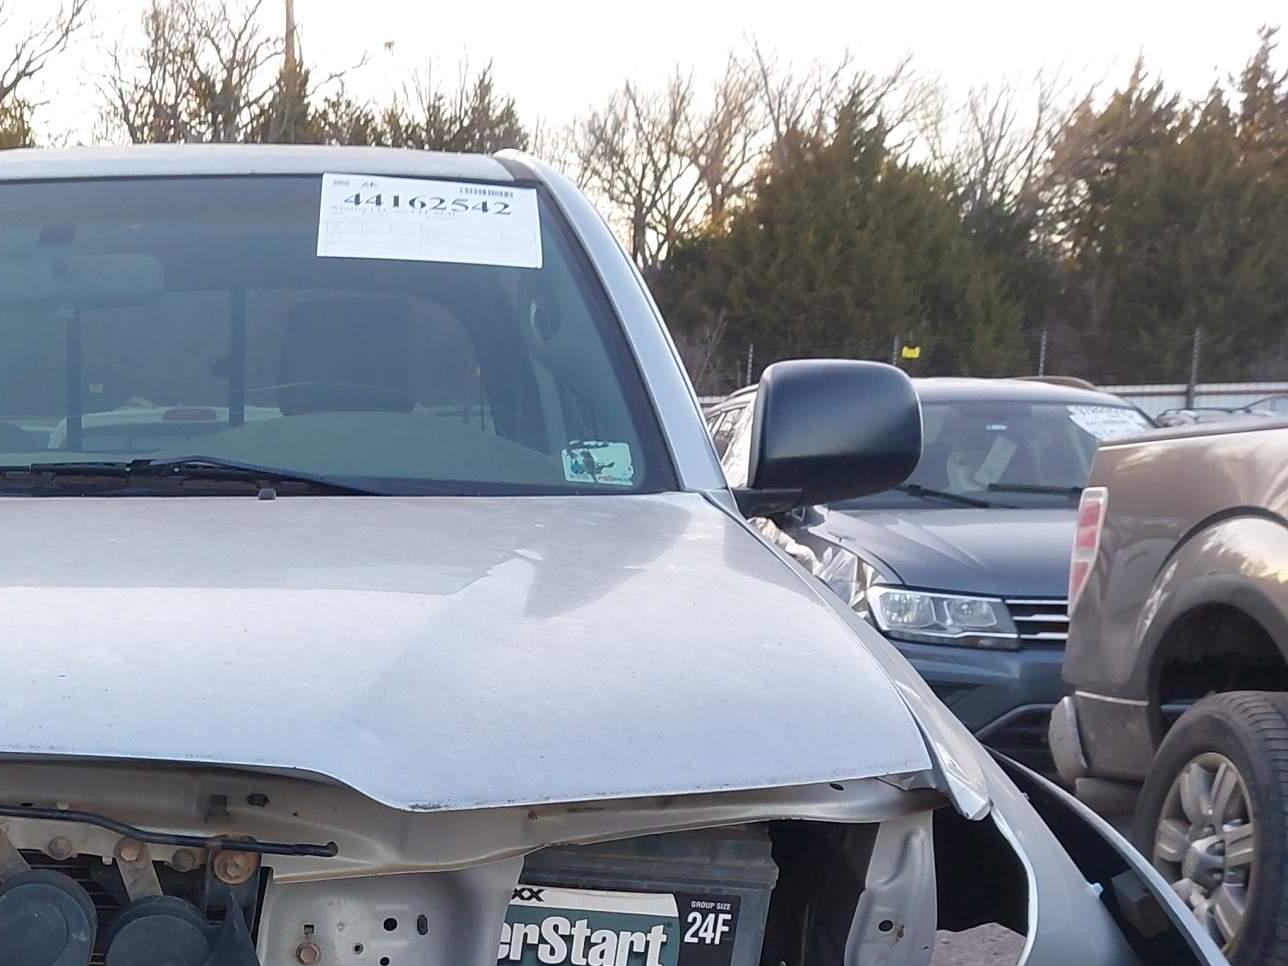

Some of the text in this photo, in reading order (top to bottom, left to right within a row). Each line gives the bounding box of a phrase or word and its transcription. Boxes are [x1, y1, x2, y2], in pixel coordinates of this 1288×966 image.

[344, 192, 512, 216] 44162542
[691, 901, 731, 911] GROUP SIZE
[684, 911, 732, 945] 24F
